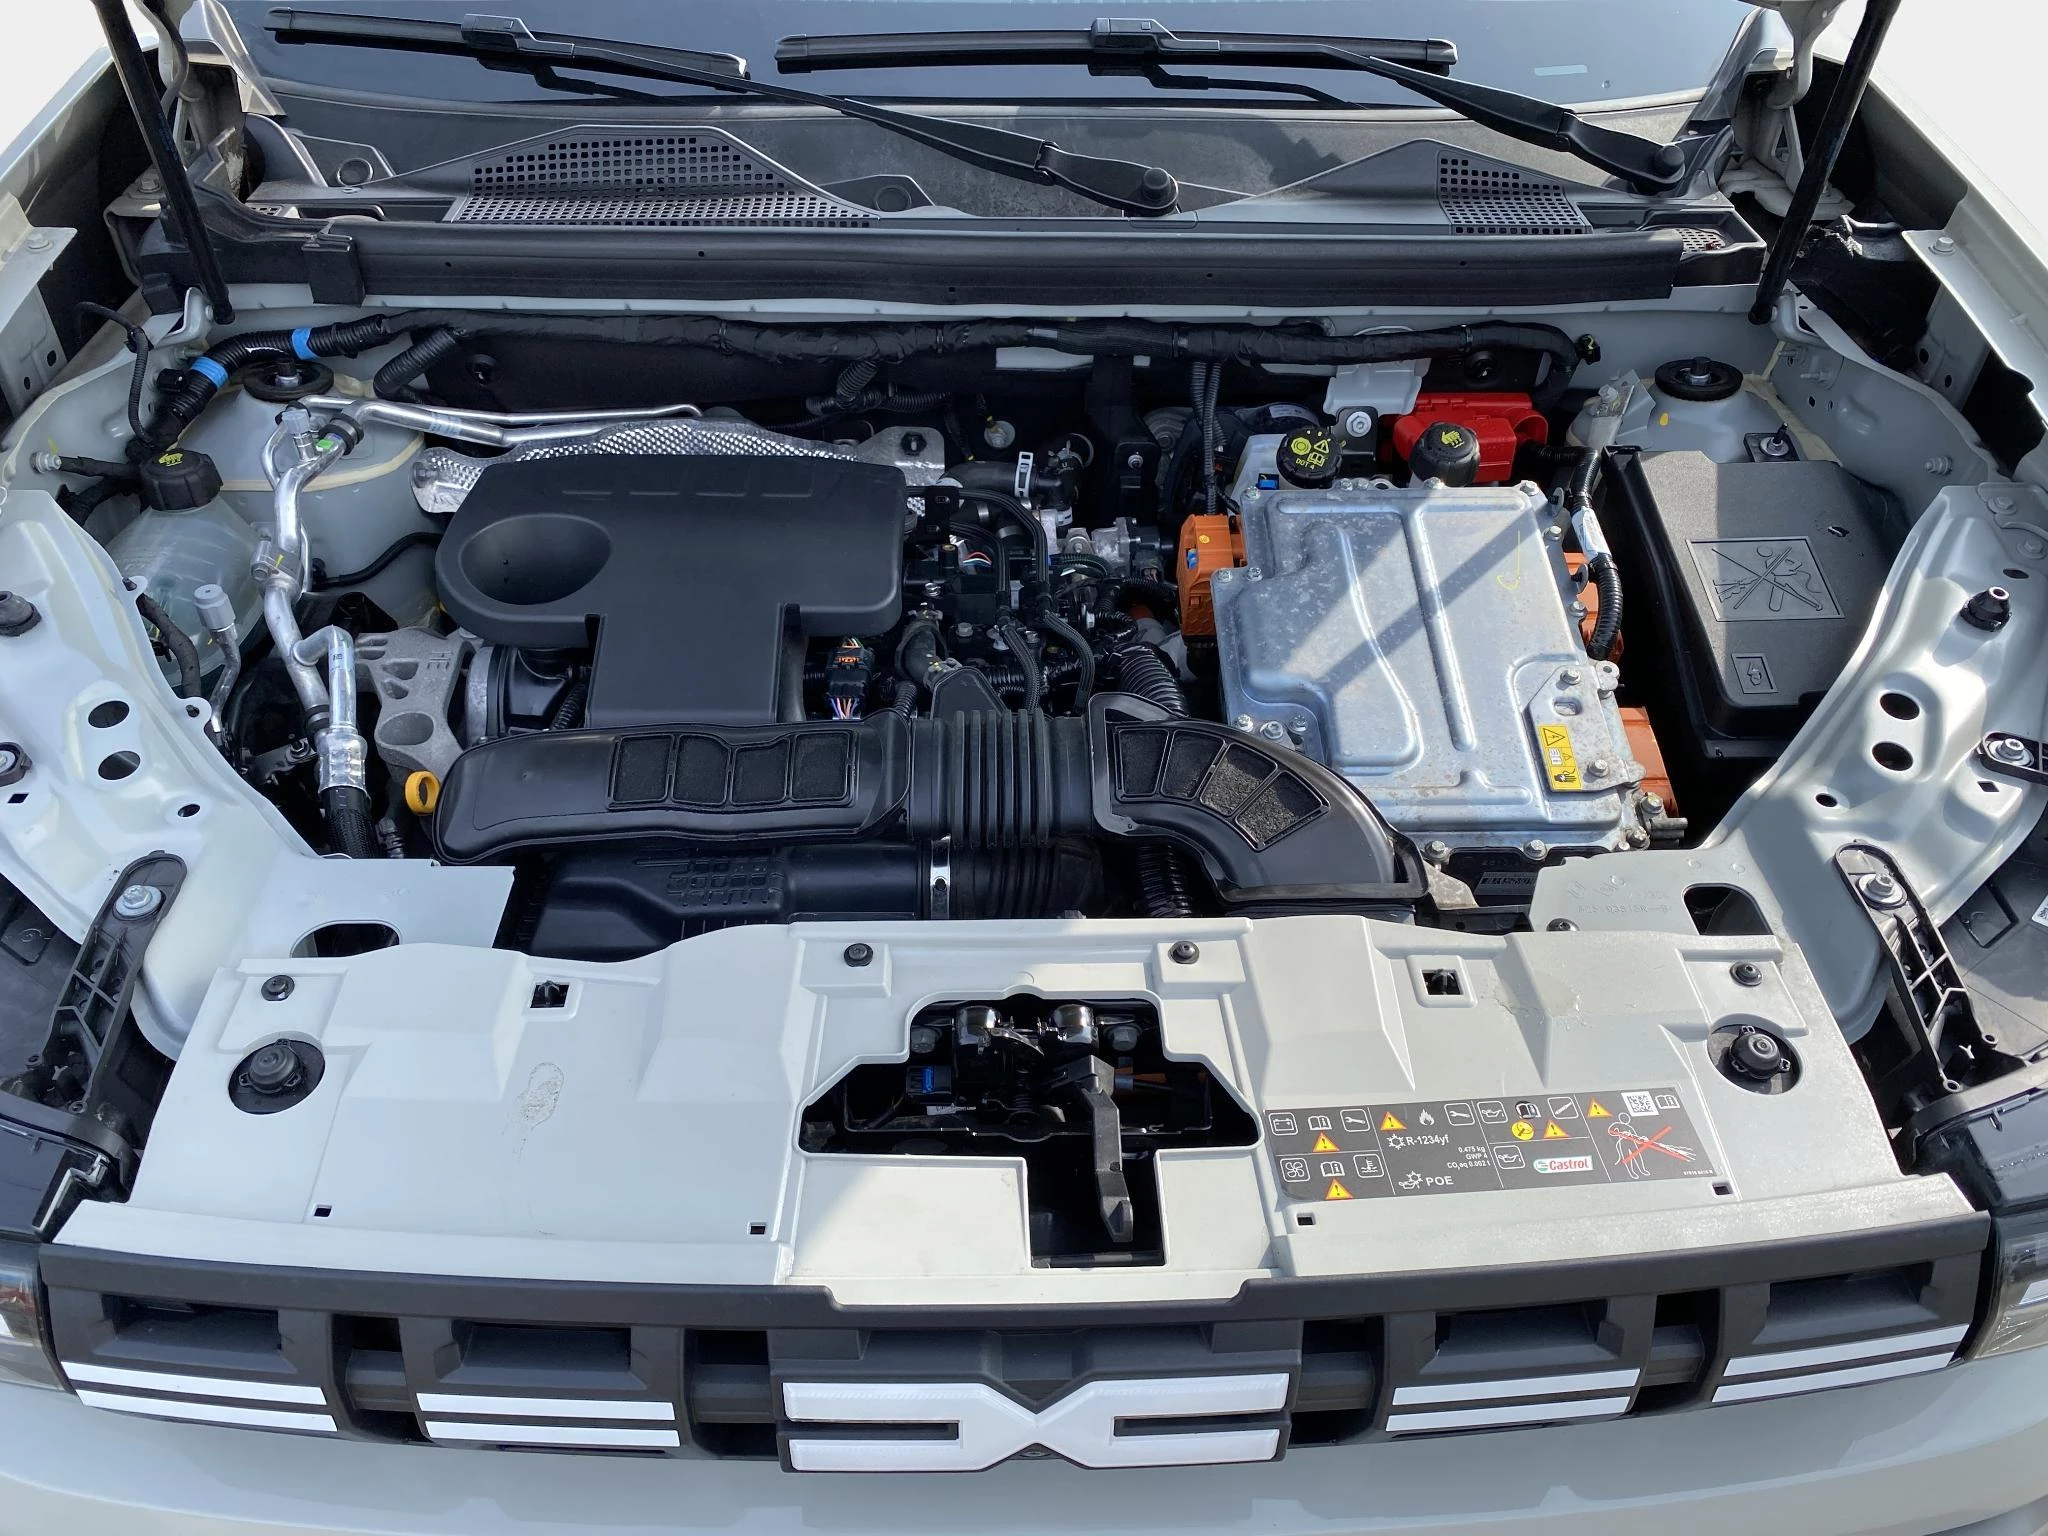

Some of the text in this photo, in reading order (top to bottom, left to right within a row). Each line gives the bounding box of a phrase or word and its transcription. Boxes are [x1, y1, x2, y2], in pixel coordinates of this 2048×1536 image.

[1295, 457, 1309, 468] DOT
[1405, 1134, 1449, 1146] R-1234yf
[1476, 1145, 1486, 1153] kg
[1549, 1158, 1589, 1171] Castrol
[1425, 1175, 1454, 1187] POE
